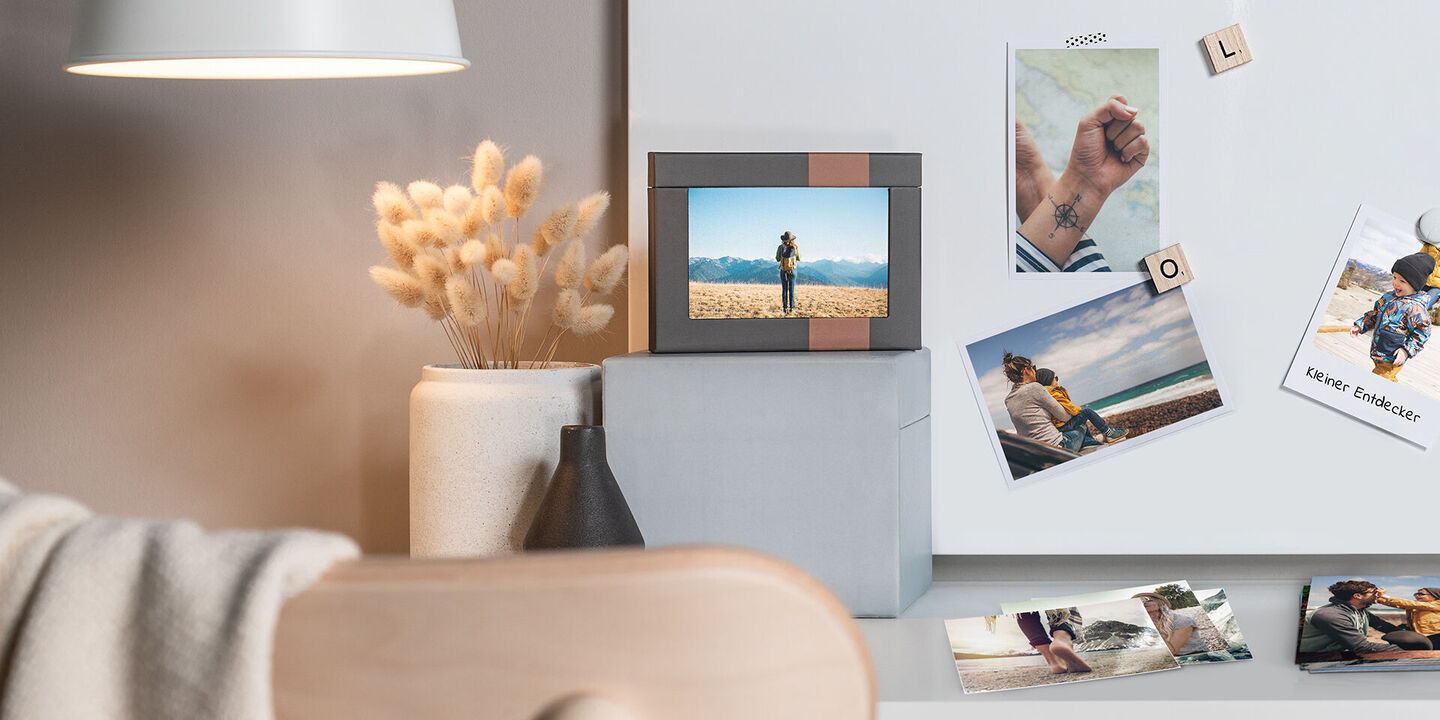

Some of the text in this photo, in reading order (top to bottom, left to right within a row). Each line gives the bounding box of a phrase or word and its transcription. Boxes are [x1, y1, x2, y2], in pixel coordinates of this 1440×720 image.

[1218, 40, 1236, 58] L
[1160, 258, 1179, 279] O
[1305, 366, 1421, 422] Kleiner Entdecker
